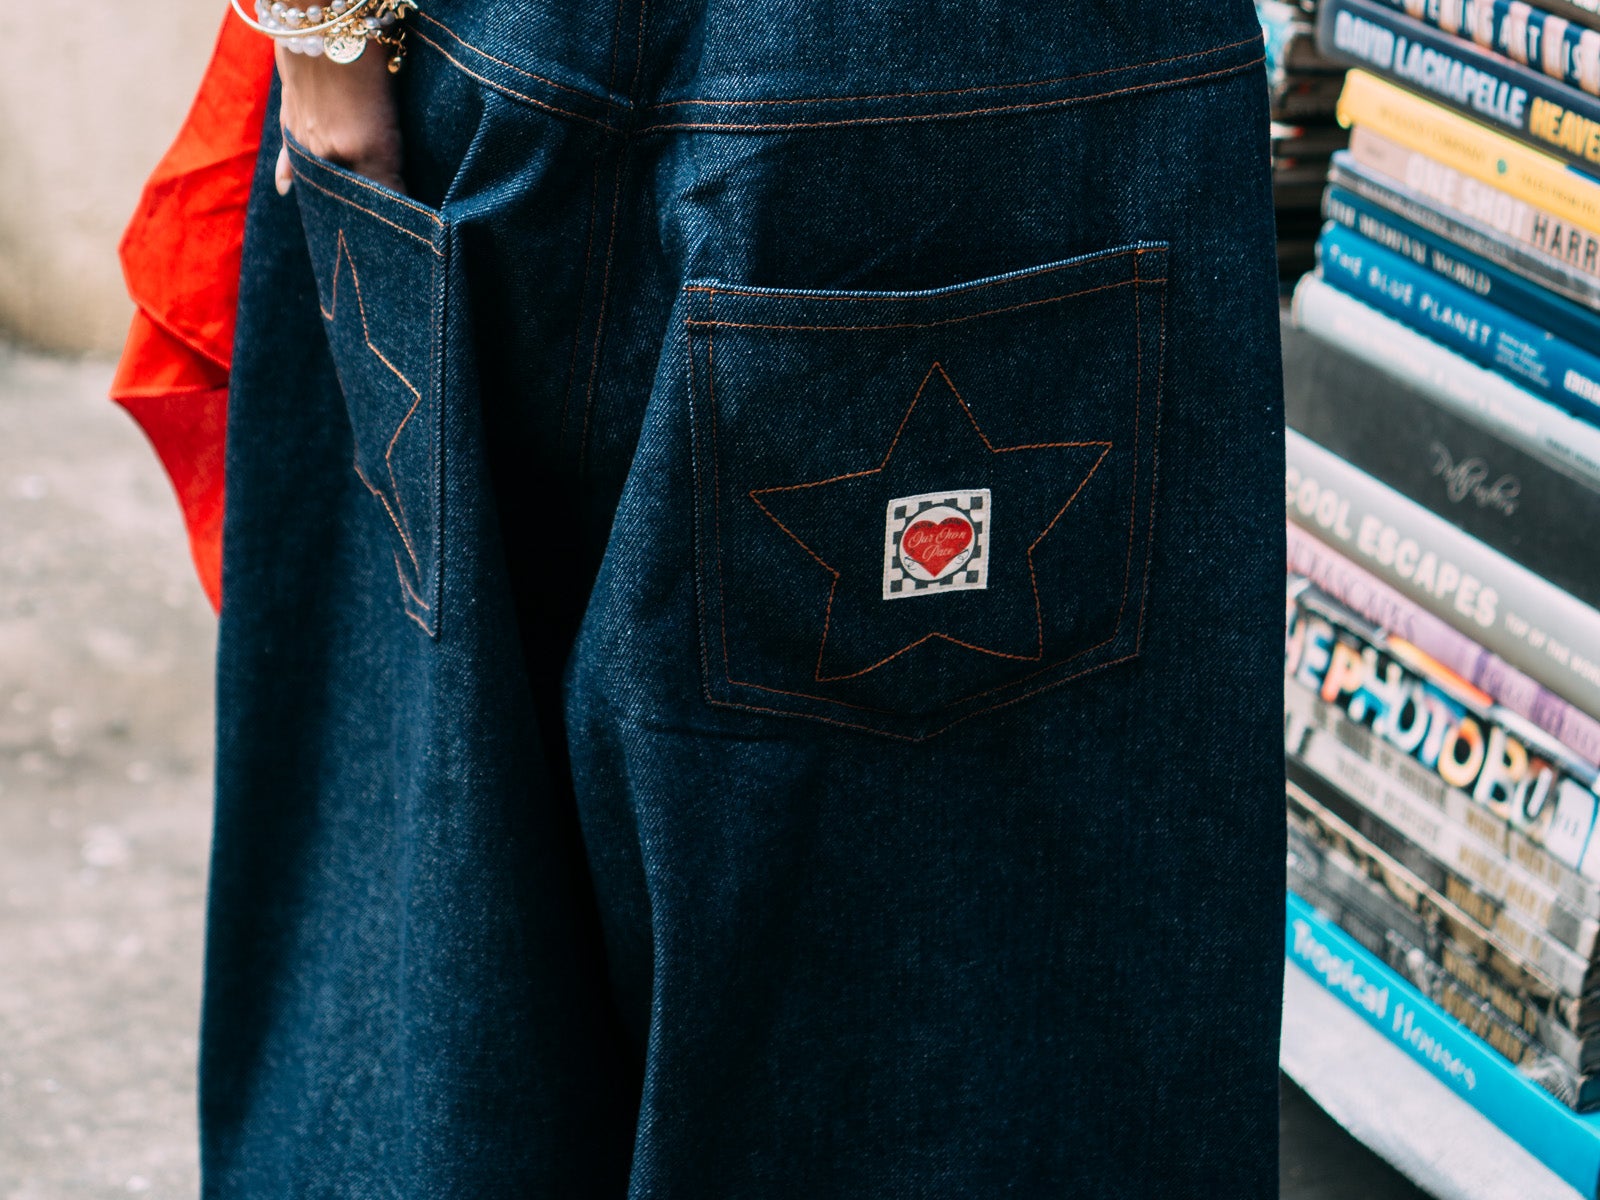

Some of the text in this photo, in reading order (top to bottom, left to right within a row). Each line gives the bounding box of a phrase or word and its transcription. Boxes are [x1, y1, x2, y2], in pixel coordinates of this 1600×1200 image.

[1333, 8, 1395, 70] DAVID
[1393, 36, 1528, 130] LACHAPELLE
[1498, 11, 1541, 63] ART
[1404, 152, 1458, 206] ONE
[1459, 177, 1527, 238] SHOT
[1329, 243, 1492, 347] THE BLUE PLANET
[1432, 249, 1492, 297] WORLD
[908, 528, 967, 548] Our Own
[1286, 465, 1354, 541] COOL
[1357, 513, 1500, 628] ESCAPES
[1291, 916, 1390, 1022] Tropical
[1391, 1002, 1476, 1091] Houses
